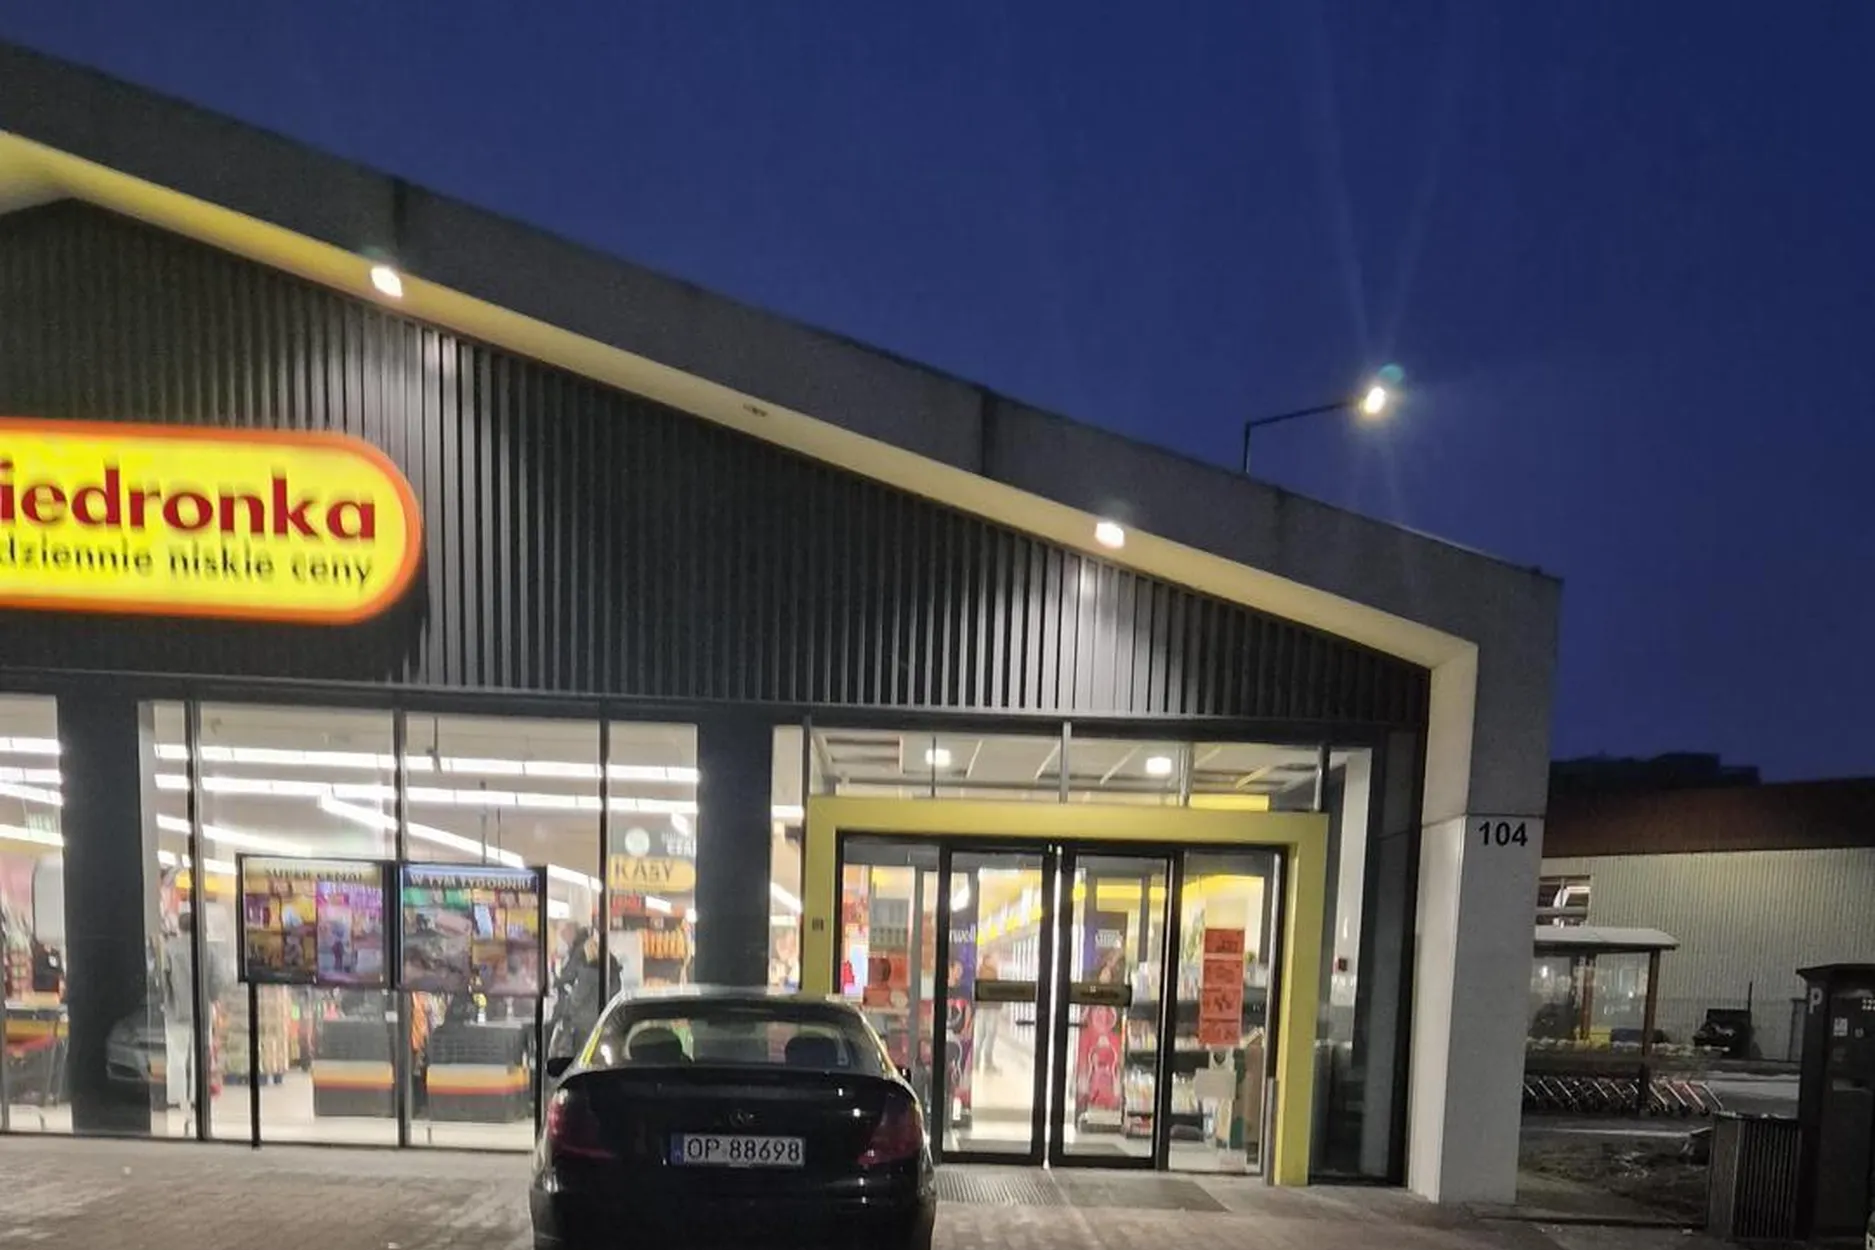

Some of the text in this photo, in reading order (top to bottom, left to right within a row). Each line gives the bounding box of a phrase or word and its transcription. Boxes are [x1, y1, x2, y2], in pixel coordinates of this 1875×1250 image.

[168, 540, 275, 581] niskie
[291, 555, 373, 589] ceny
[1479, 821, 1528, 847] 104
[615, 857, 673, 882] KASY
[1809, 987, 1823, 1014] P
[687, 1137, 800, 1162] OP 88698
